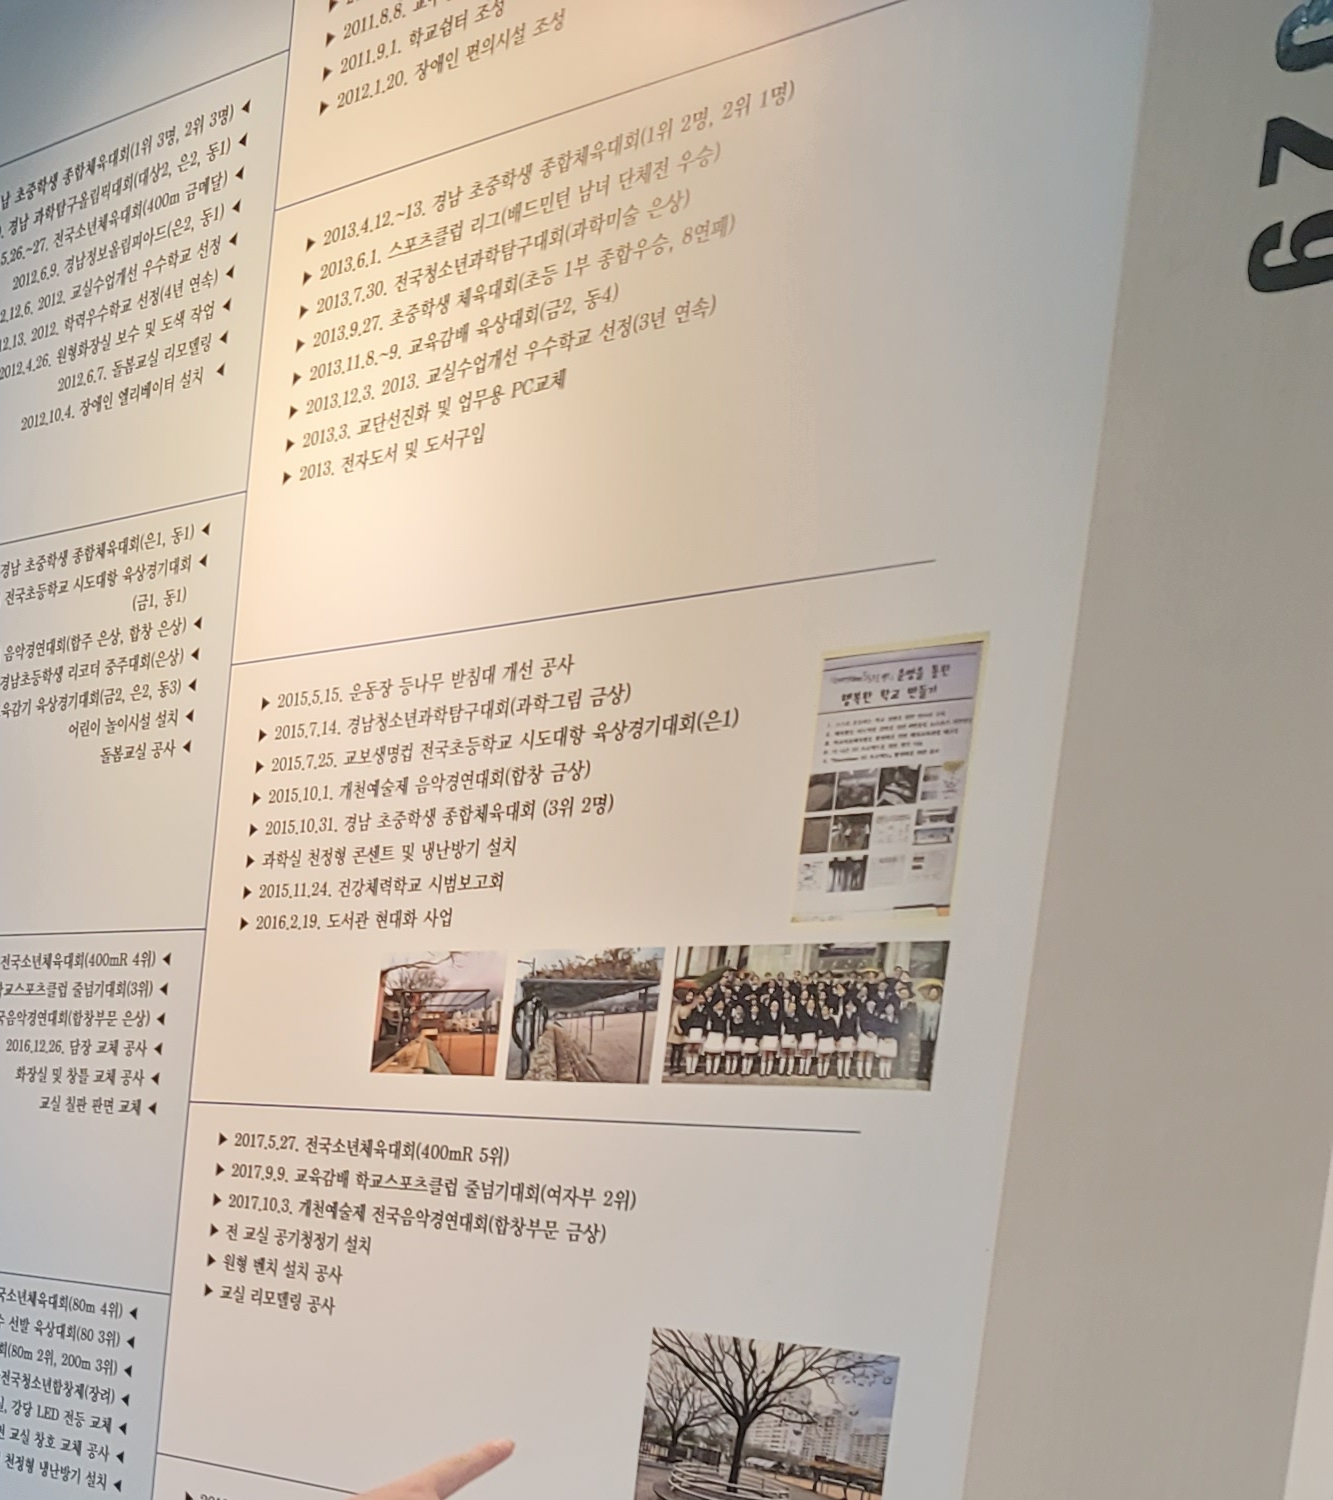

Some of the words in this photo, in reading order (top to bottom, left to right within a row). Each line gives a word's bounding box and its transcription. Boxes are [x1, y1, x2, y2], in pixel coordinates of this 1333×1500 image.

[433, 185, 463, 213] 경남
[468, 162, 533, 200] 초중학생
[681, 106, 713, 132] 2명,
[723, 93, 751, 119] 2위
[761, 80, 795, 108] 1명)
[388, 219, 464, 259] 스포츠클럽
[471, 186, 570, 234] 리그(배드민턴
[579, 174, 610, 203] 남녀
[619, 156, 669, 190] 단체전
[681, 143, 720, 172] 우승)
[381, 373, 419, 396] 2013.
[426, 344, 518, 384] 교실수업개선
[525, 328, 591, 361] 우수학교
[600, 306, 665, 342] 선정(3년
[675, 295, 716, 324] 연속)
[302, 423, 350, 448] 2013.3.
[357, 401, 431, 435] 교단선진화
[438, 396, 451, 419] 및
[458, 384, 505, 413] 업무용
[511, 368, 567, 399] PC교체
[299, 460, 334, 481] 2013.
[342, 443, 398, 474] 전자도서
[405, 438, 418, 460] 및
[424, 422, 485, 453] 도서구입
[349, 678, 393, 702] 운동장
[399, 672, 444, 696] 등나무
[452, 664, 496, 689] 받침대
[503, 659, 533, 682] 개선
[540, 653, 575, 678] 공사
[262, 849, 302, 869] 과학실
[308, 846, 346, 867] 천정형
[353, 844, 394, 865] 콘센트
[402, 842, 414, 862] 및
[422, 838, 480, 861] 냉난방기
[487, 835, 517, 857] 설치
[338, 876, 421, 898] 건강체력학교
[429, 871, 504, 894] 시범보고회
[327, 910, 369, 930] 도서관
[376, 908, 418, 929] 현대화
[423, 907, 453, 928] 사업
[479, 1146, 509, 1167] 5위)
[223, 1253, 248, 1273] 원형
[253, 1257, 278, 1277] 벤치
[283, 1260, 309, 1281] 설치
[315, 1264, 343, 1285] 공사
